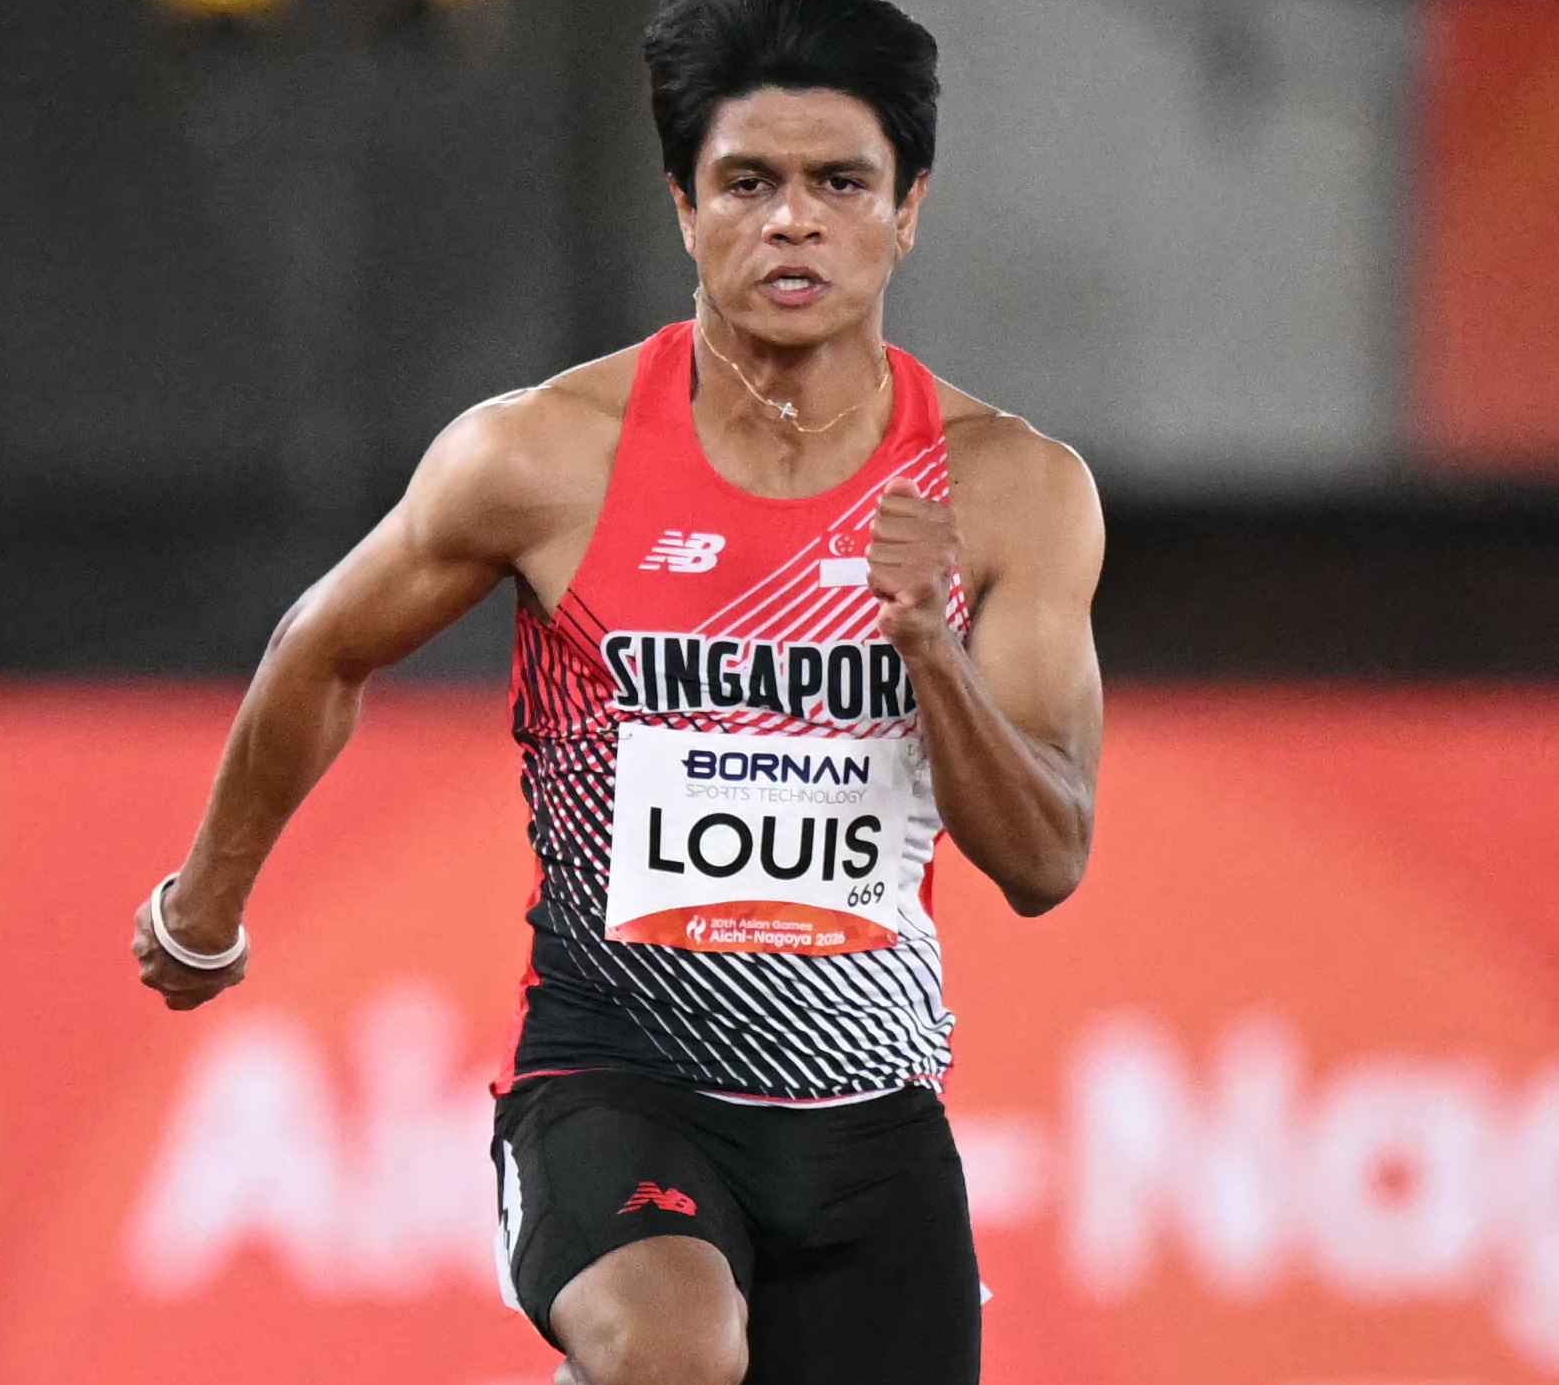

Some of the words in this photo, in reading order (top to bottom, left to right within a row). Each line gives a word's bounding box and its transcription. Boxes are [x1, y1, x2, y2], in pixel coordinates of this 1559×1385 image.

[605, 635, 917, 719] SINGAPOR
[681, 749, 870, 785] BORNAN
[685, 784, 750, 801] SPORTS
[757, 786, 867, 804] TECHNOLOGY
[648, 806, 882, 881] LOUIS
[847, 881, 885, 907] 669
[709, 929, 811, 947] Aichi-Nagoya
[740, 920, 770, 931] Asian
[773, 920, 813, 931] Games
